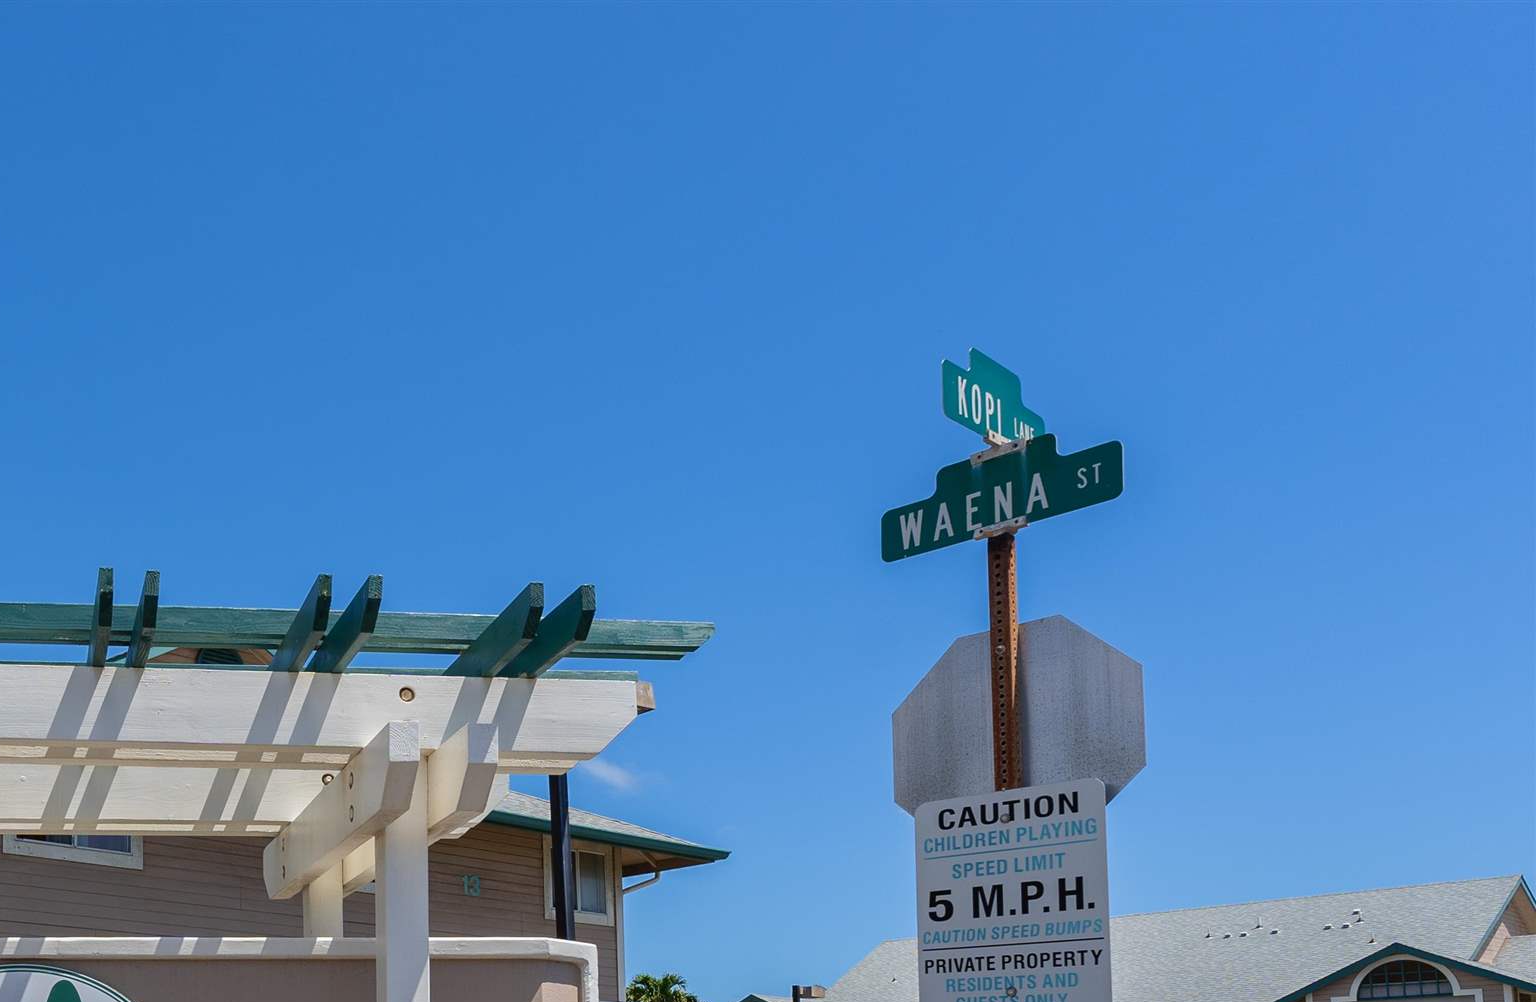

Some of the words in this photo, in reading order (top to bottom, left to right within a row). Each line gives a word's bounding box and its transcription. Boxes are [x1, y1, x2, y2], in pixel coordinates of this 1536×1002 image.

[958, 375, 1002, 436] KOPI
[900, 472, 1048, 550] WAENA
[1077, 462, 1102, 488] ST
[938, 792, 1078, 830] CAUTION
[924, 829, 1010, 853] CHILDREN
[1017, 818, 1097, 842] PLAYING
[952, 859, 1007, 879] SPEED
[1015, 852, 1065, 872] LIMIT
[928, 889, 954, 922] 5
[972, 876, 1095, 919] M.P.H.
[923, 928, 986, 945] CAUTION
[992, 924, 1040, 940] SPEED
[1045, 919, 1103, 936] BUMPS
[924, 956, 995, 974] PRIVATE
[1002, 950, 1103, 970] PROPERTY
[946, 975, 1036, 992] RESIDENTS
[1042, 973, 1078, 988] AND
